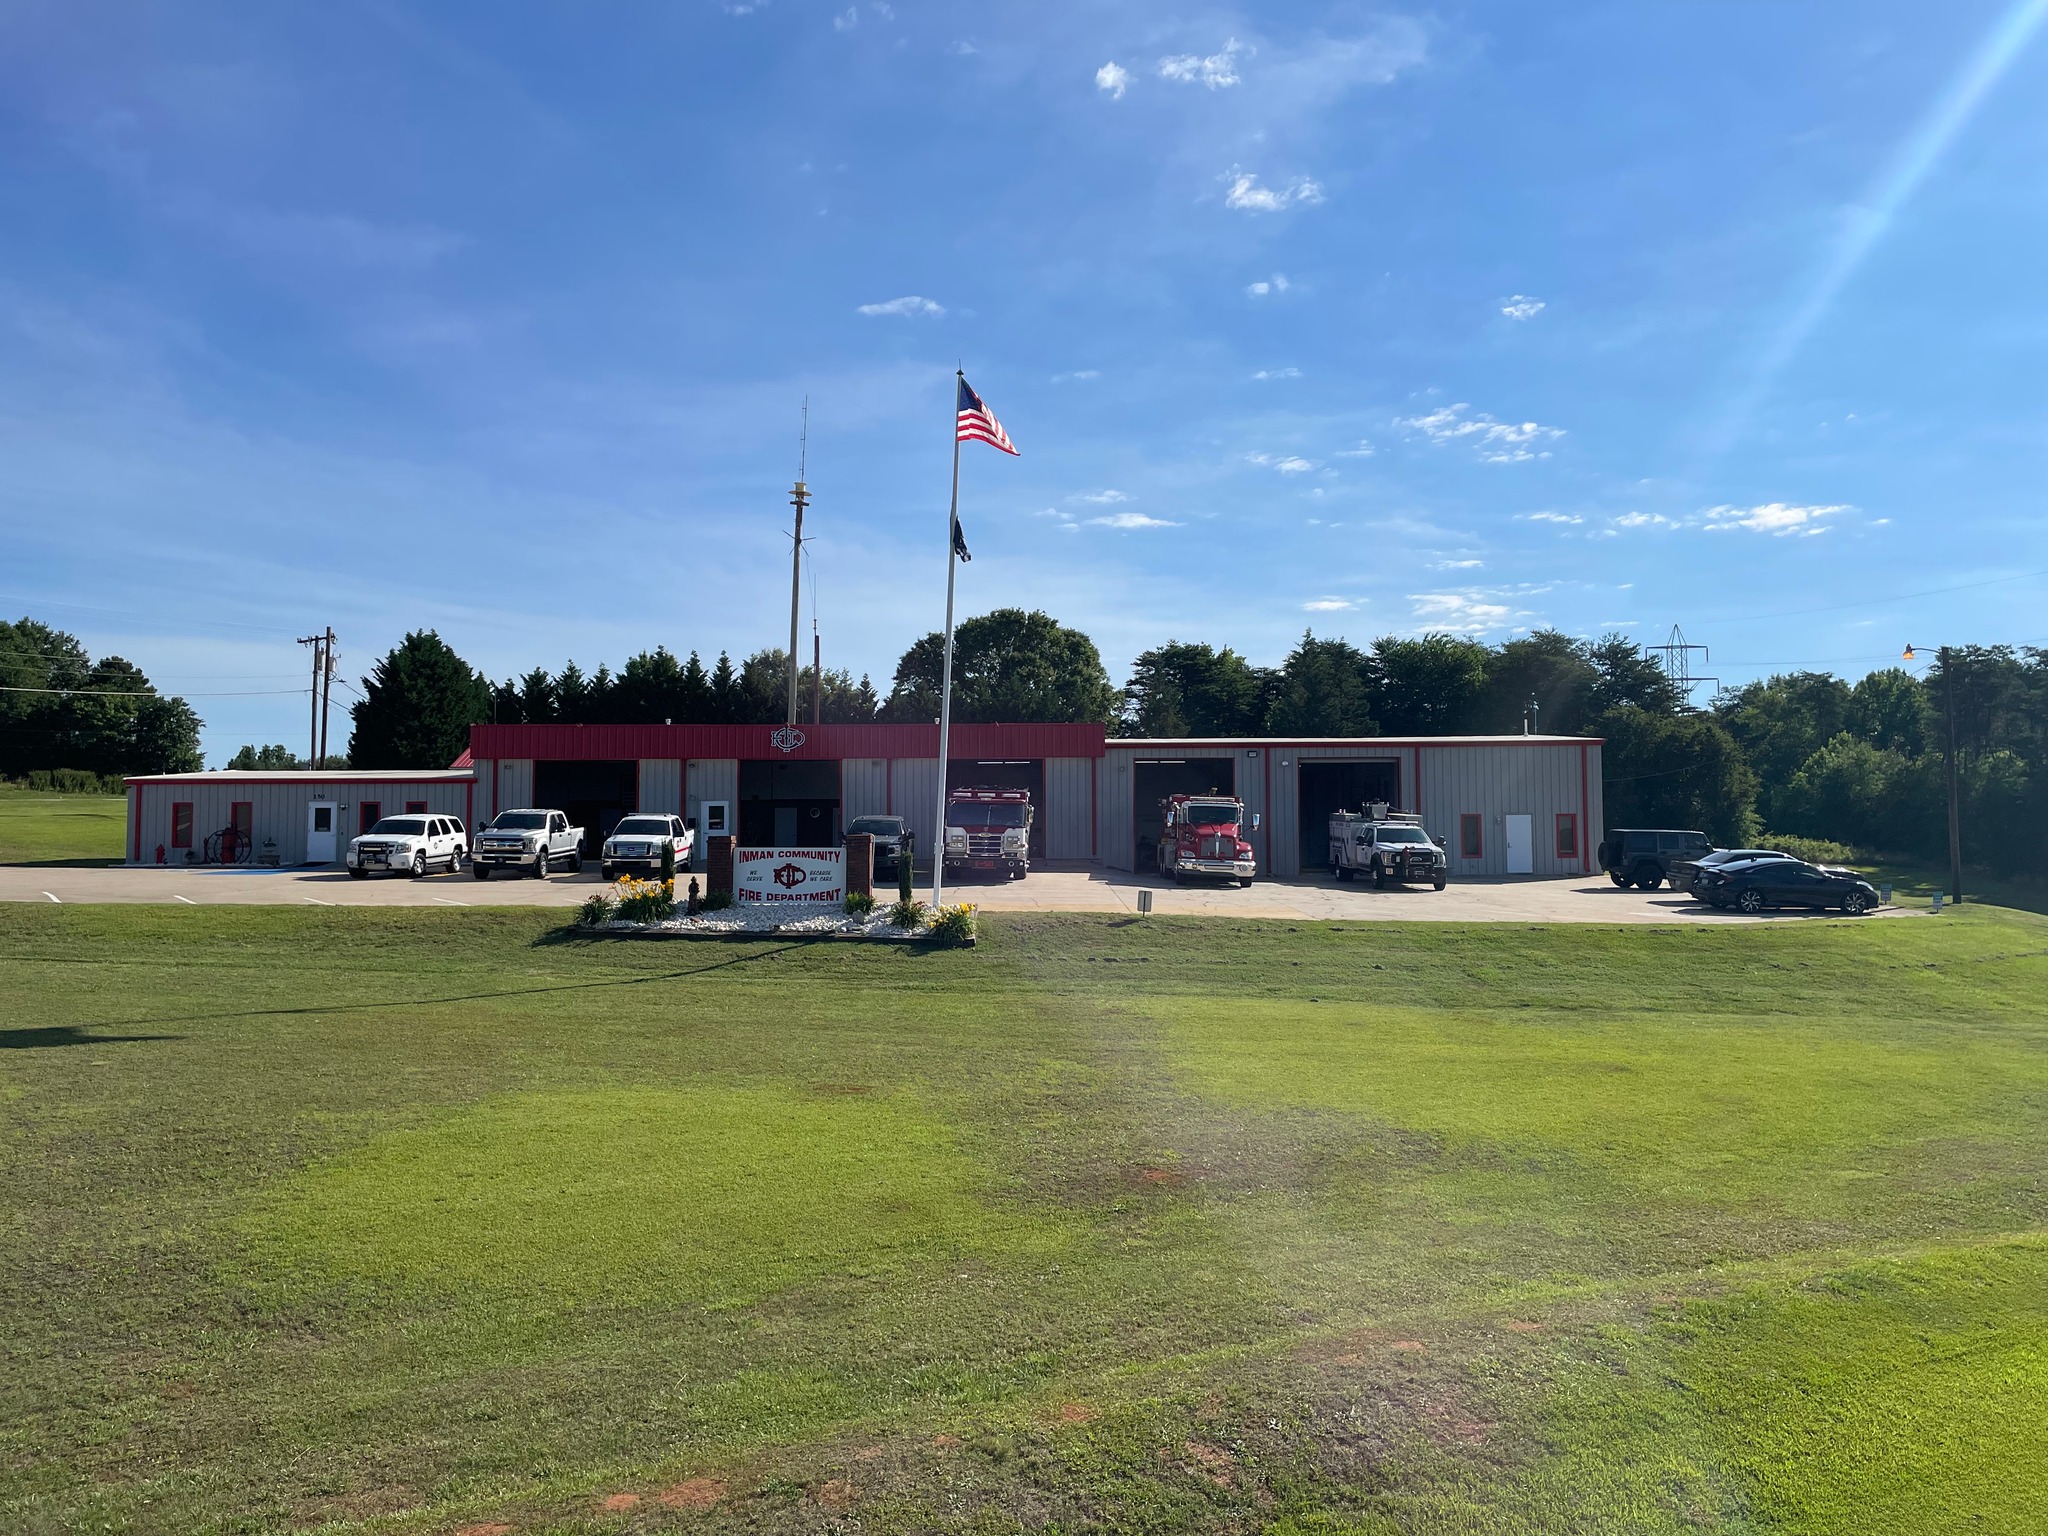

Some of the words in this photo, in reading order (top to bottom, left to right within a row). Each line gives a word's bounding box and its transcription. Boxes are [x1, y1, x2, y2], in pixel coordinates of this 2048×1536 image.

[739, 850, 774, 864] INMAN
[778, 850, 841, 864] COMMUNITY
[738, 887, 762, 901] FIRE
[766, 887, 841, 902] DEPARTMENT
